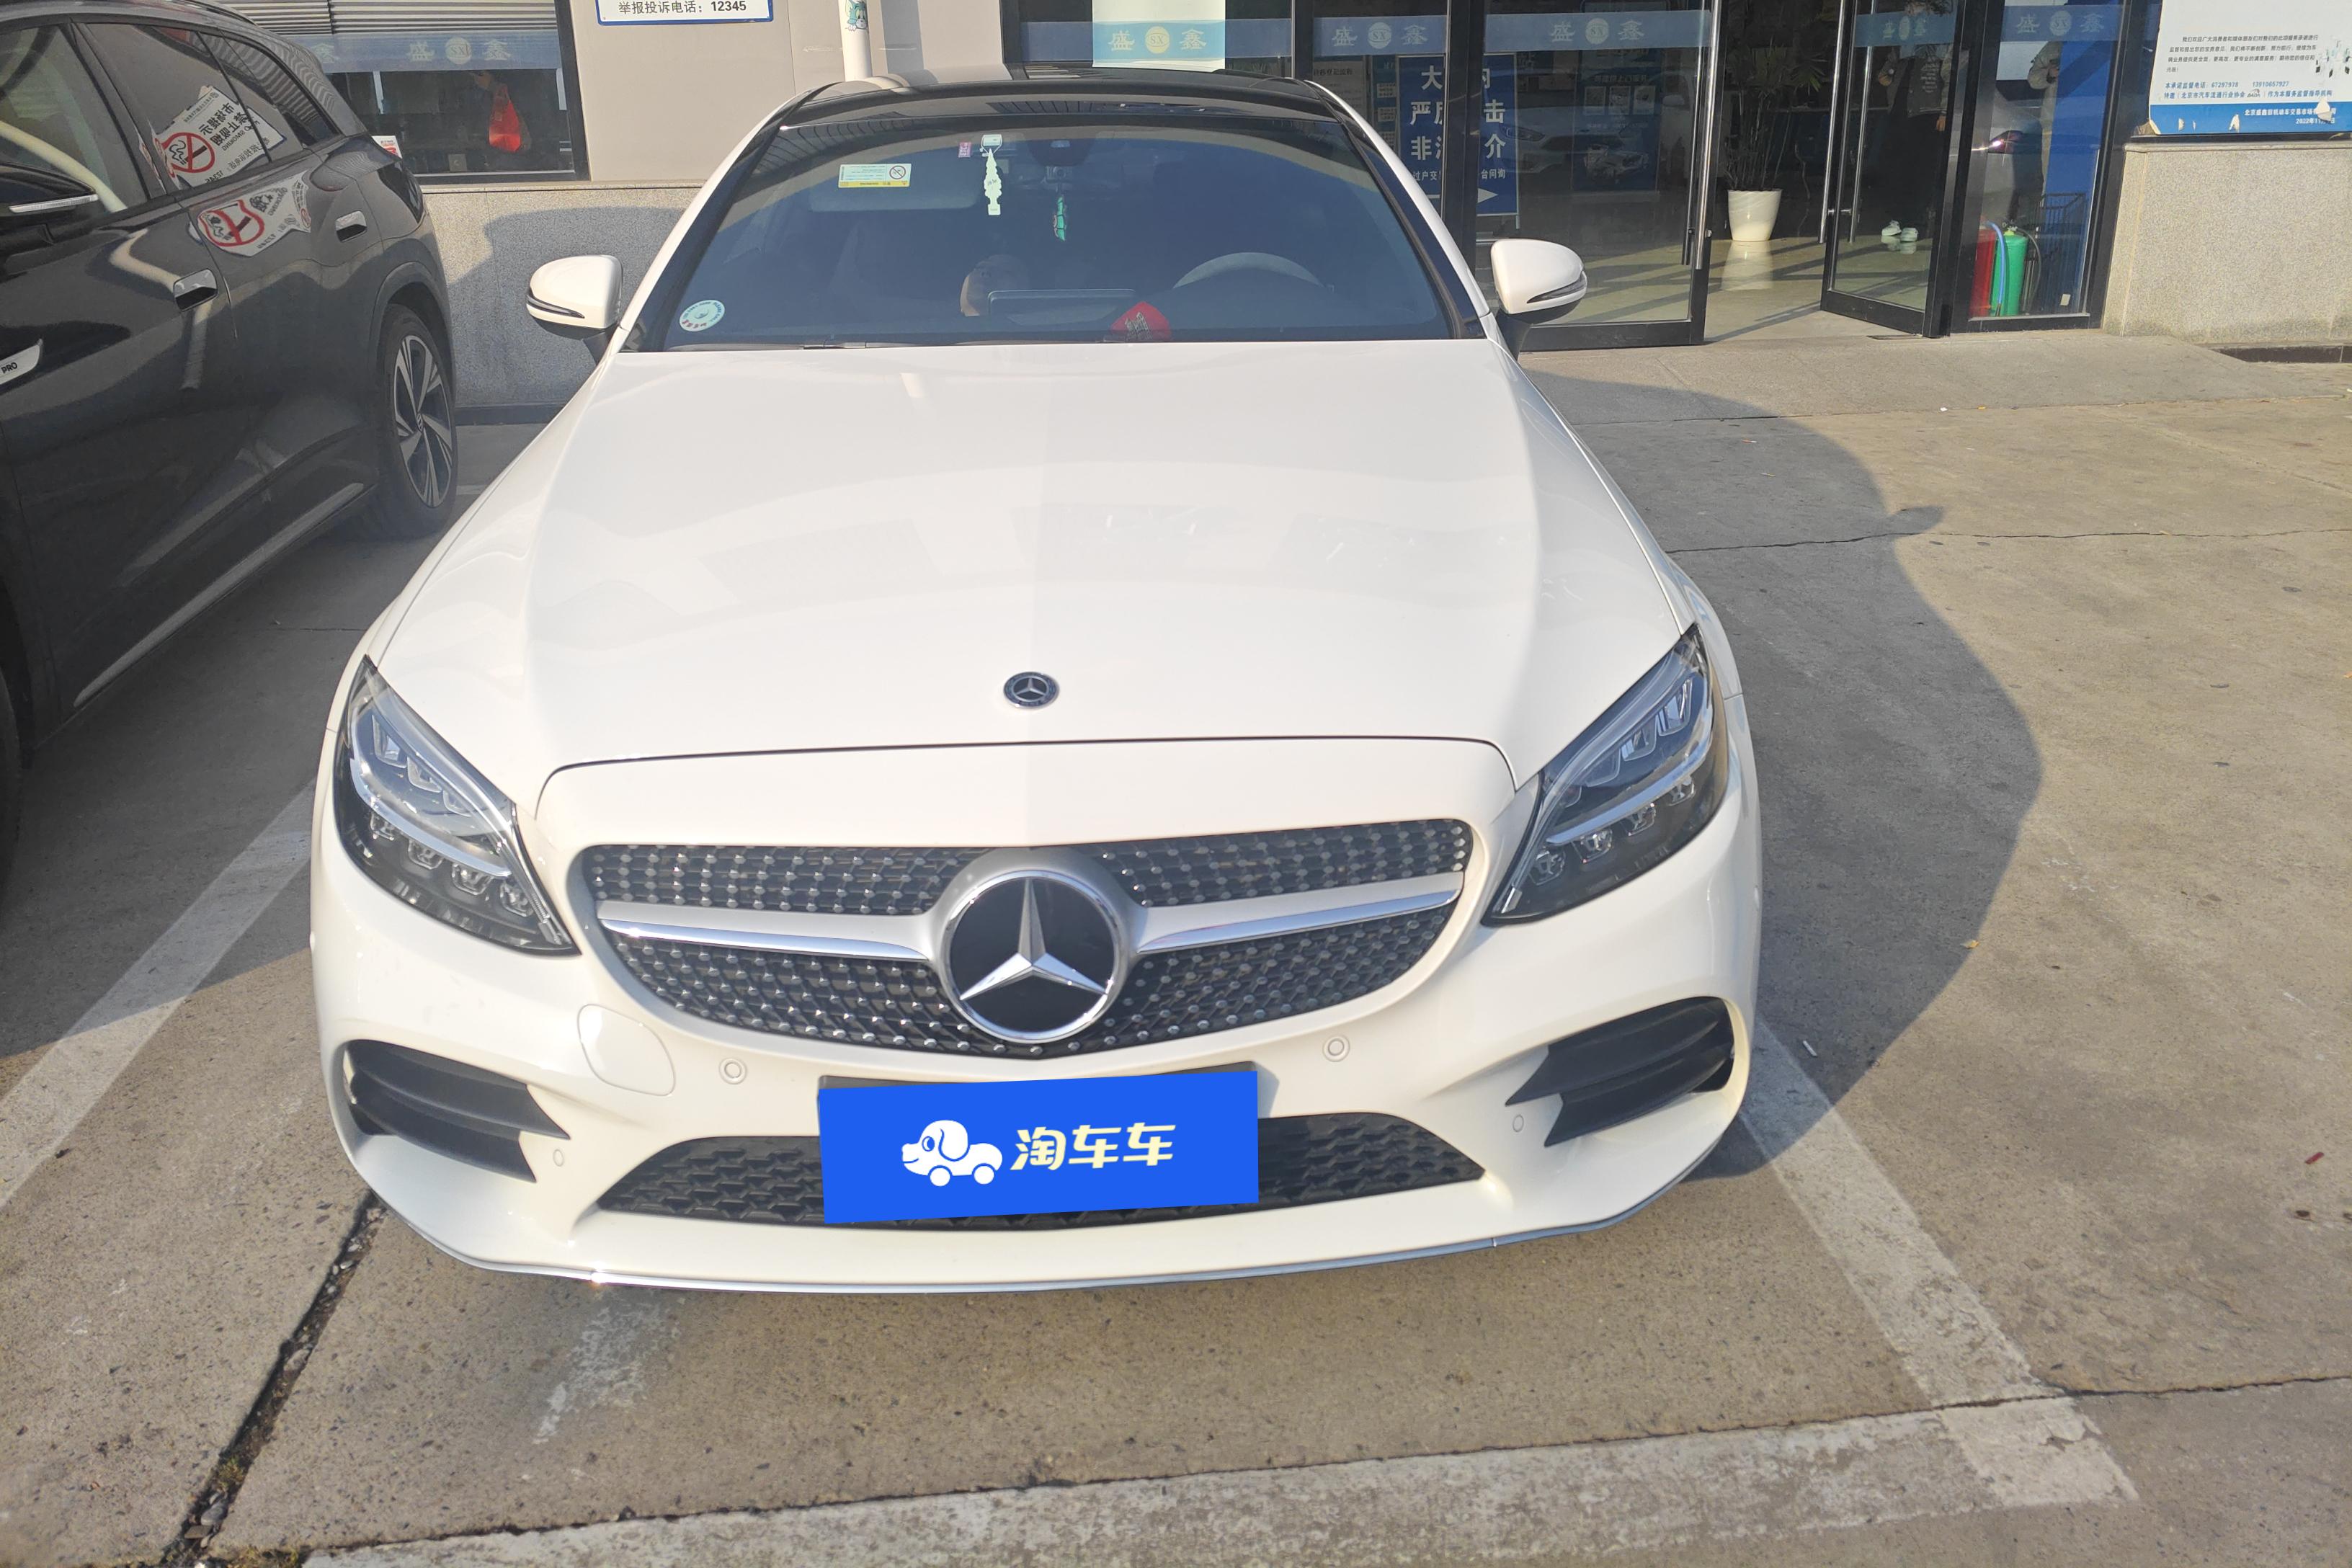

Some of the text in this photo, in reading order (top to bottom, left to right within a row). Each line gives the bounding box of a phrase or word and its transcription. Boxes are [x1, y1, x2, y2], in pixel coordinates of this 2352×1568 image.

[710, 1, 747, 12] 12345
[1108, 30, 1136, 51] 盛
[1180, 27, 1208, 50] 鑫
[1332, 25, 1358, 47] 盛
[1400, 24, 1428, 45] 鑫
[1551, 21, 1575, 42] 盛
[1618, 20, 1644, 40] 鑫
[407, 40, 435, 62] 盛
[483, 39, 512, 61] 鑫
[1, 362, 18, 374] PRO
